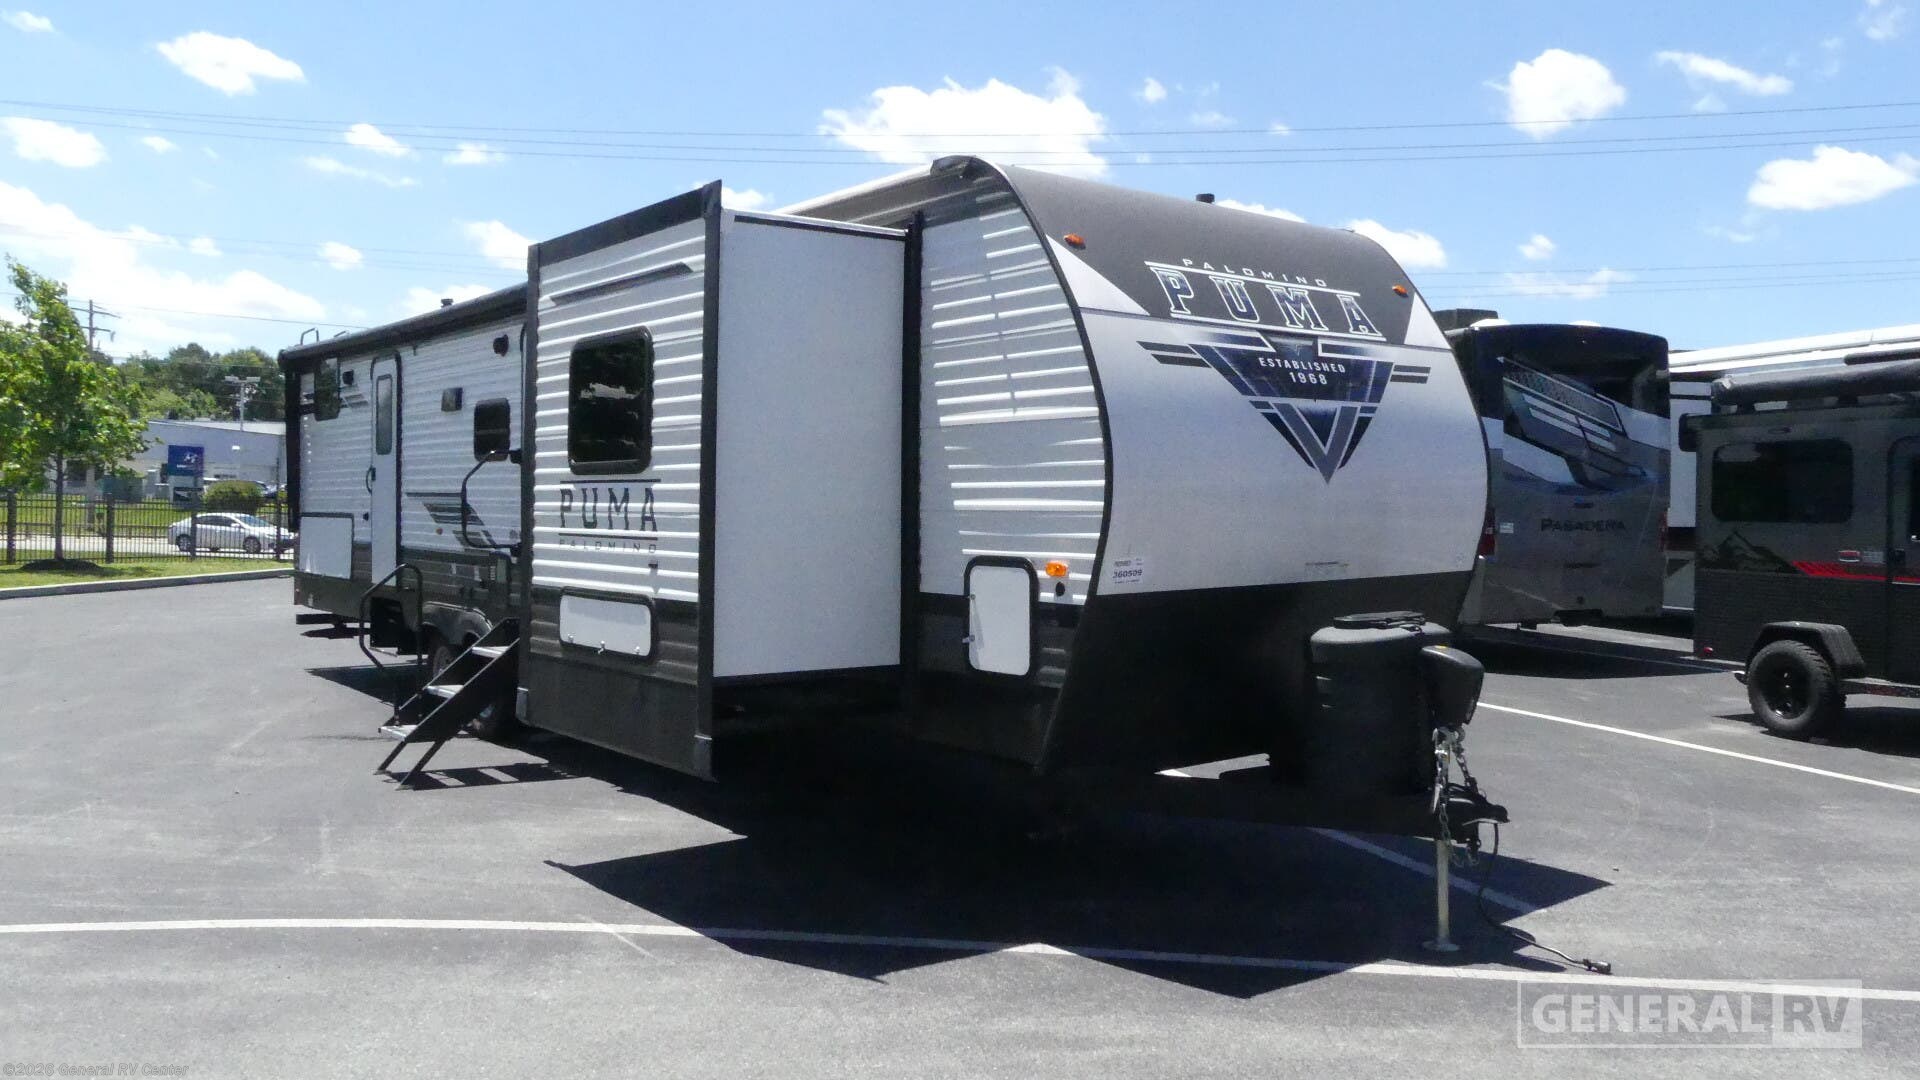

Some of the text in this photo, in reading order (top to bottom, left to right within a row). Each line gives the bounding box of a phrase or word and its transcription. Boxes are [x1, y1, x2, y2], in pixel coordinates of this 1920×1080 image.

[1182, 258, 1327, 287] PALOMINO
[1150, 266, 1384, 337] PUMA
[1258, 357, 1346, 374] ESTABLISHED
[1289, 371, 1328, 385] 1968
[559, 487, 658, 532] PUMA
[559, 539, 657, 554] PALOMINO
